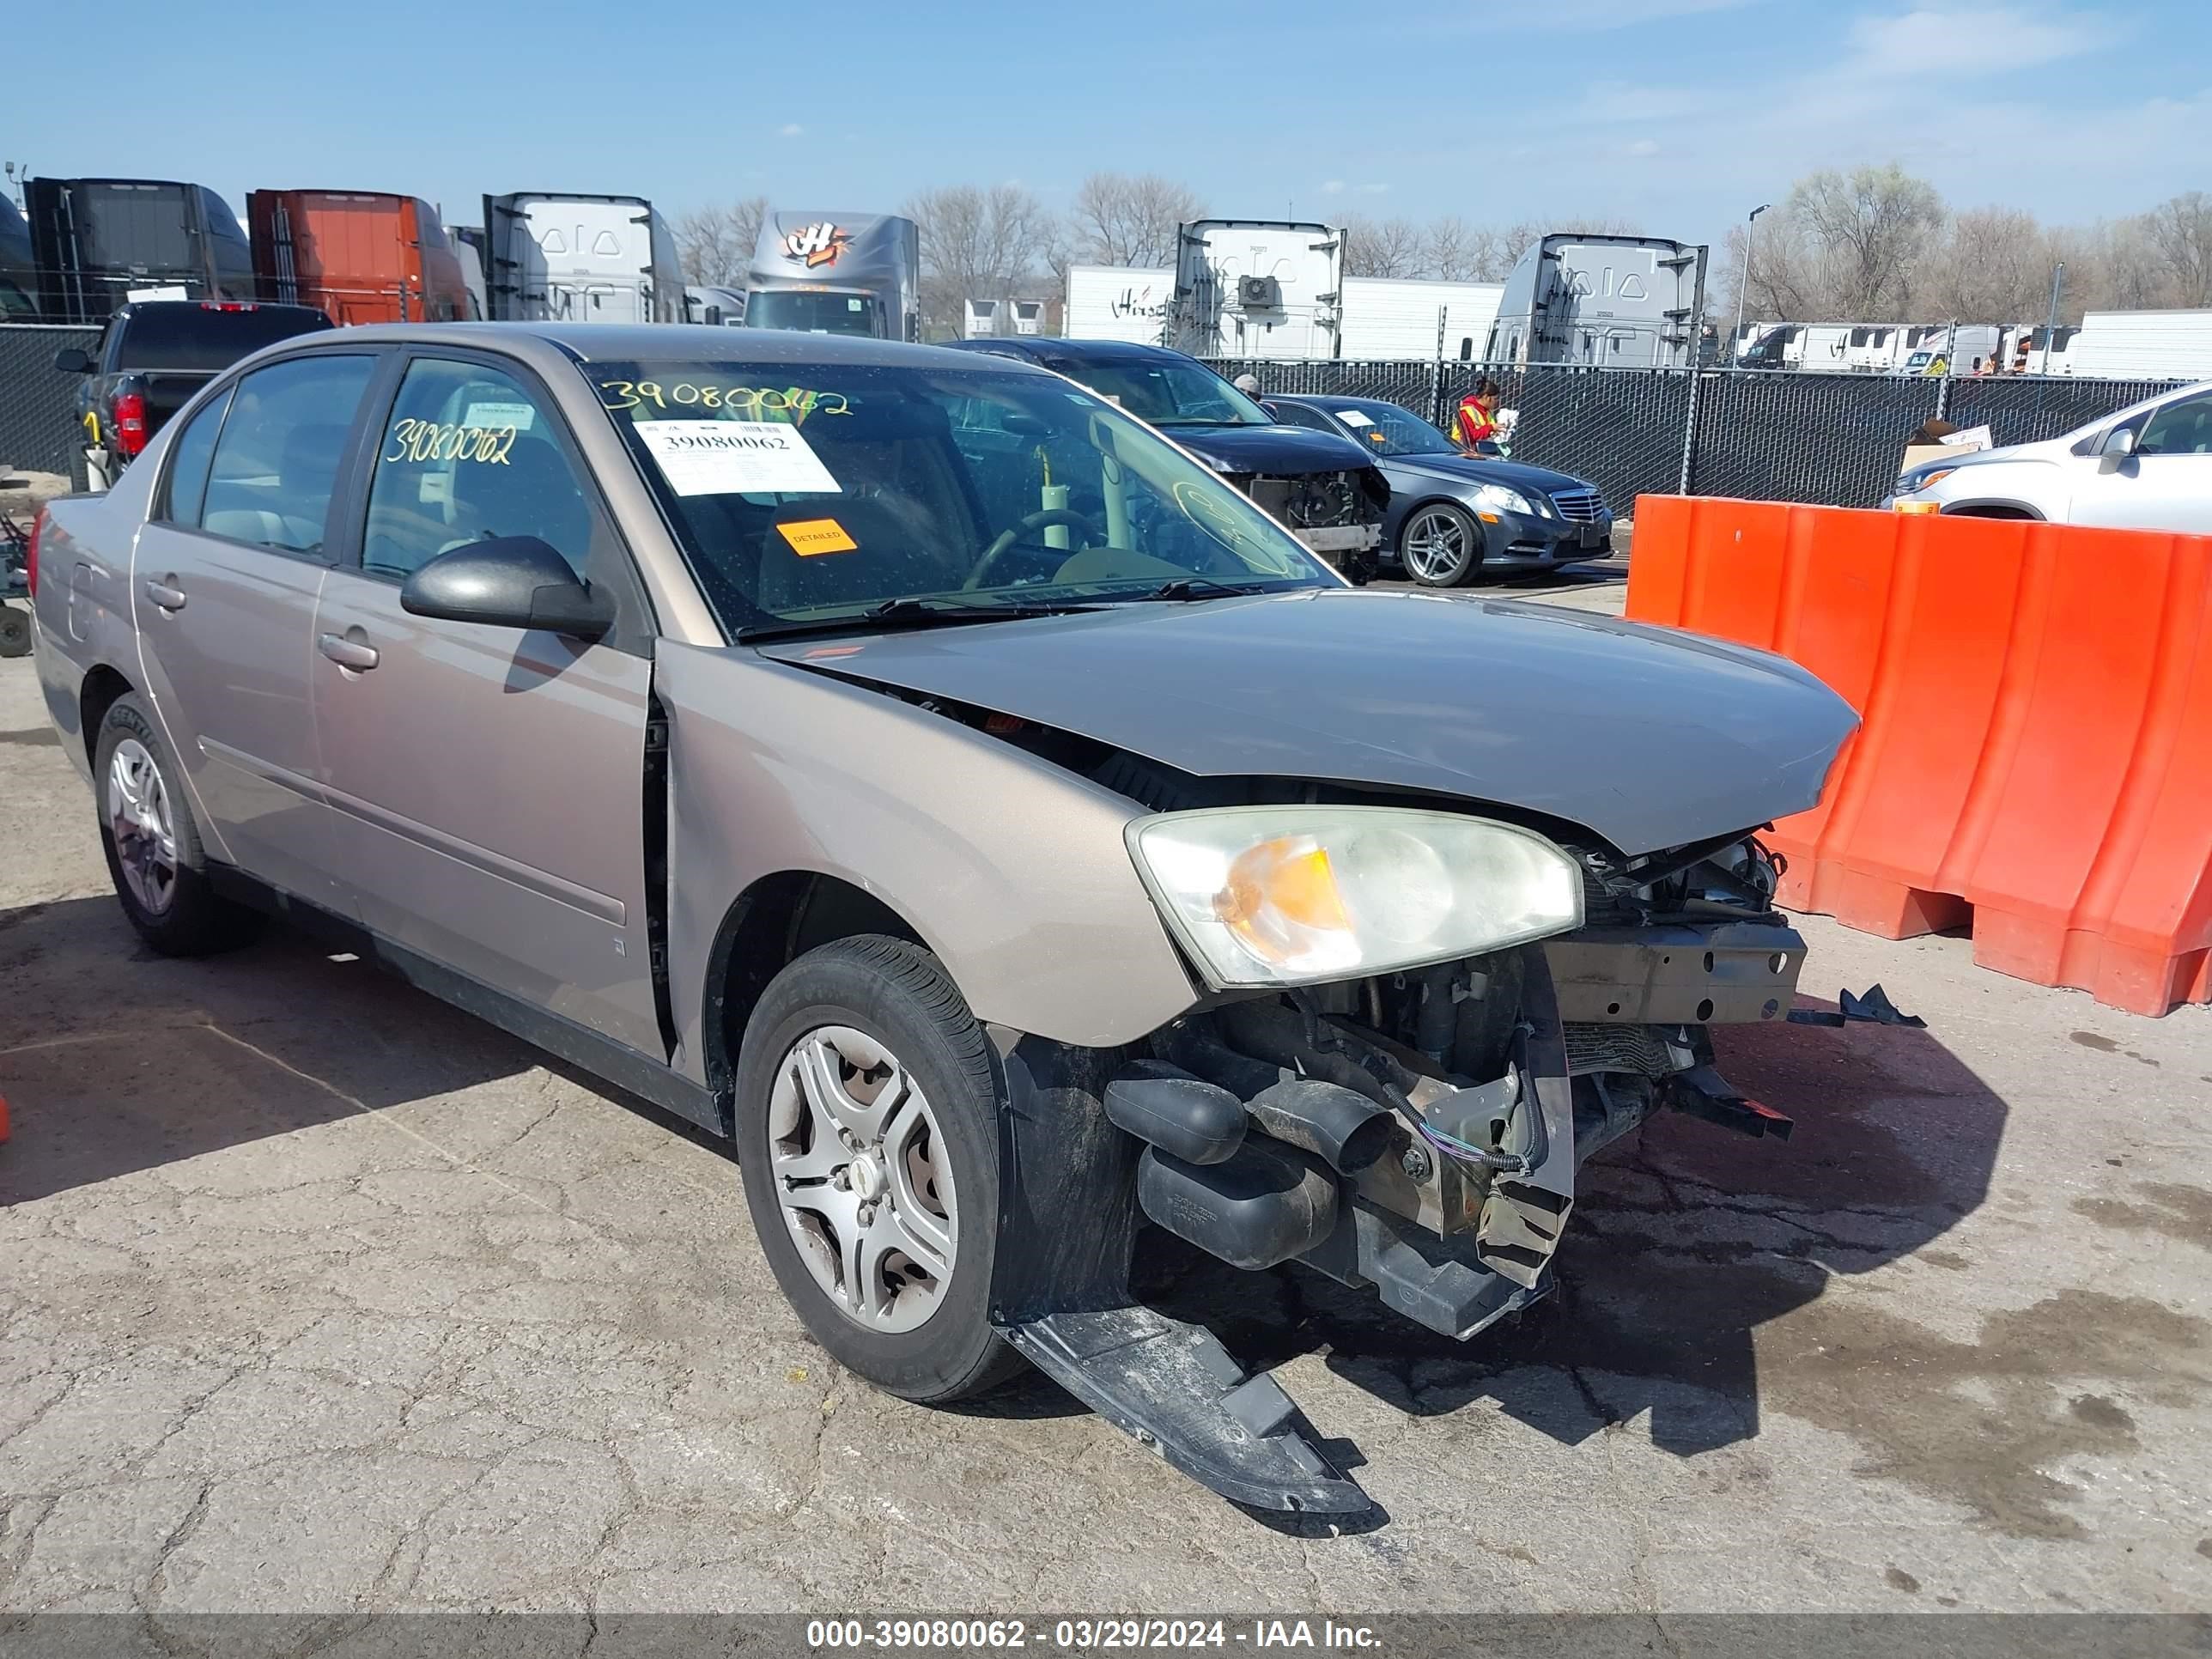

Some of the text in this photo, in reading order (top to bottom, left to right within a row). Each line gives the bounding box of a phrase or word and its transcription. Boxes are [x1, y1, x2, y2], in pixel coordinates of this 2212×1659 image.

[600, 381, 854, 416] 39080062
[386, 418, 516, 465] 39080062
[663, 435, 790, 450] 39080062
[793, 532, 841, 543] DETAILED
